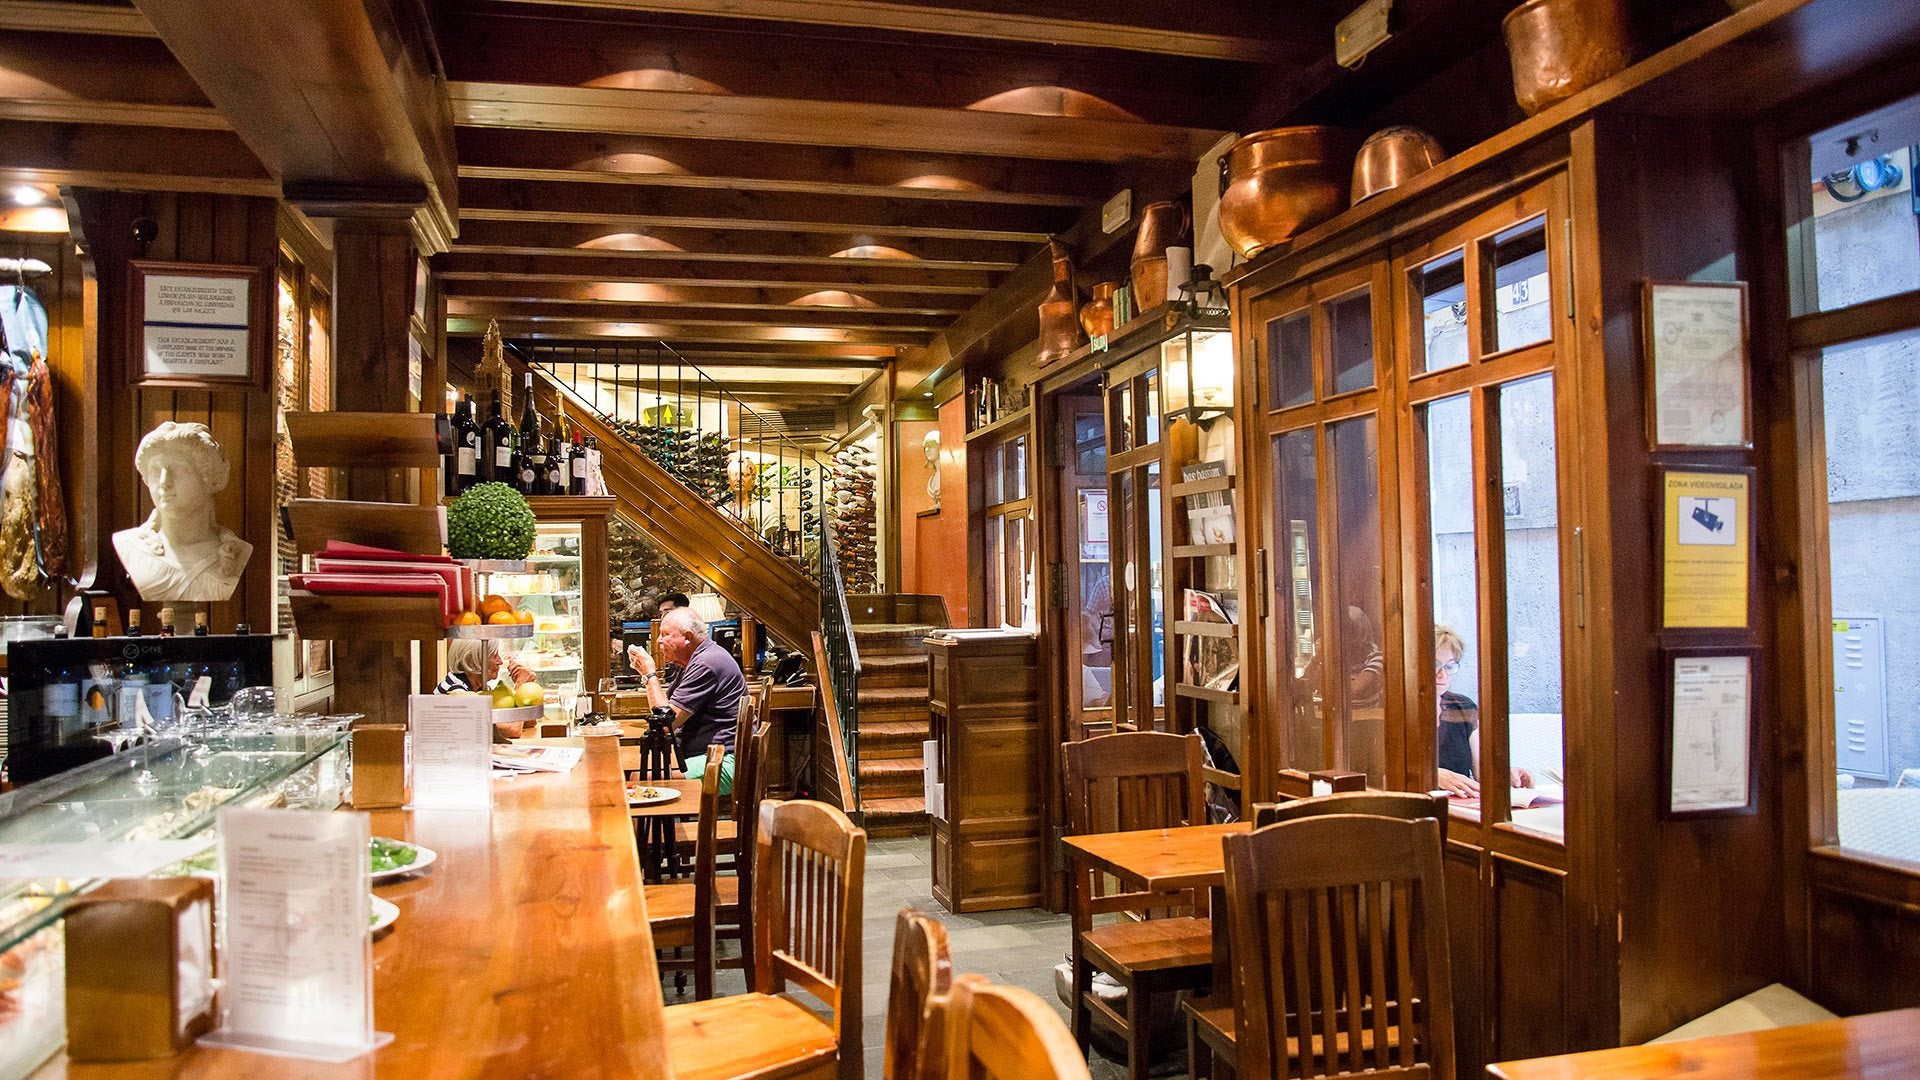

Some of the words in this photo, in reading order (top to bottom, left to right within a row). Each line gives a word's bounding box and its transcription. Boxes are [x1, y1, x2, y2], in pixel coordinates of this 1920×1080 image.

[1512, 280, 1529, 304] 43
[1668, 480, 1687, 488] ZONA
[1689, 481, 1744, 490] VIDEOVIGILADA
